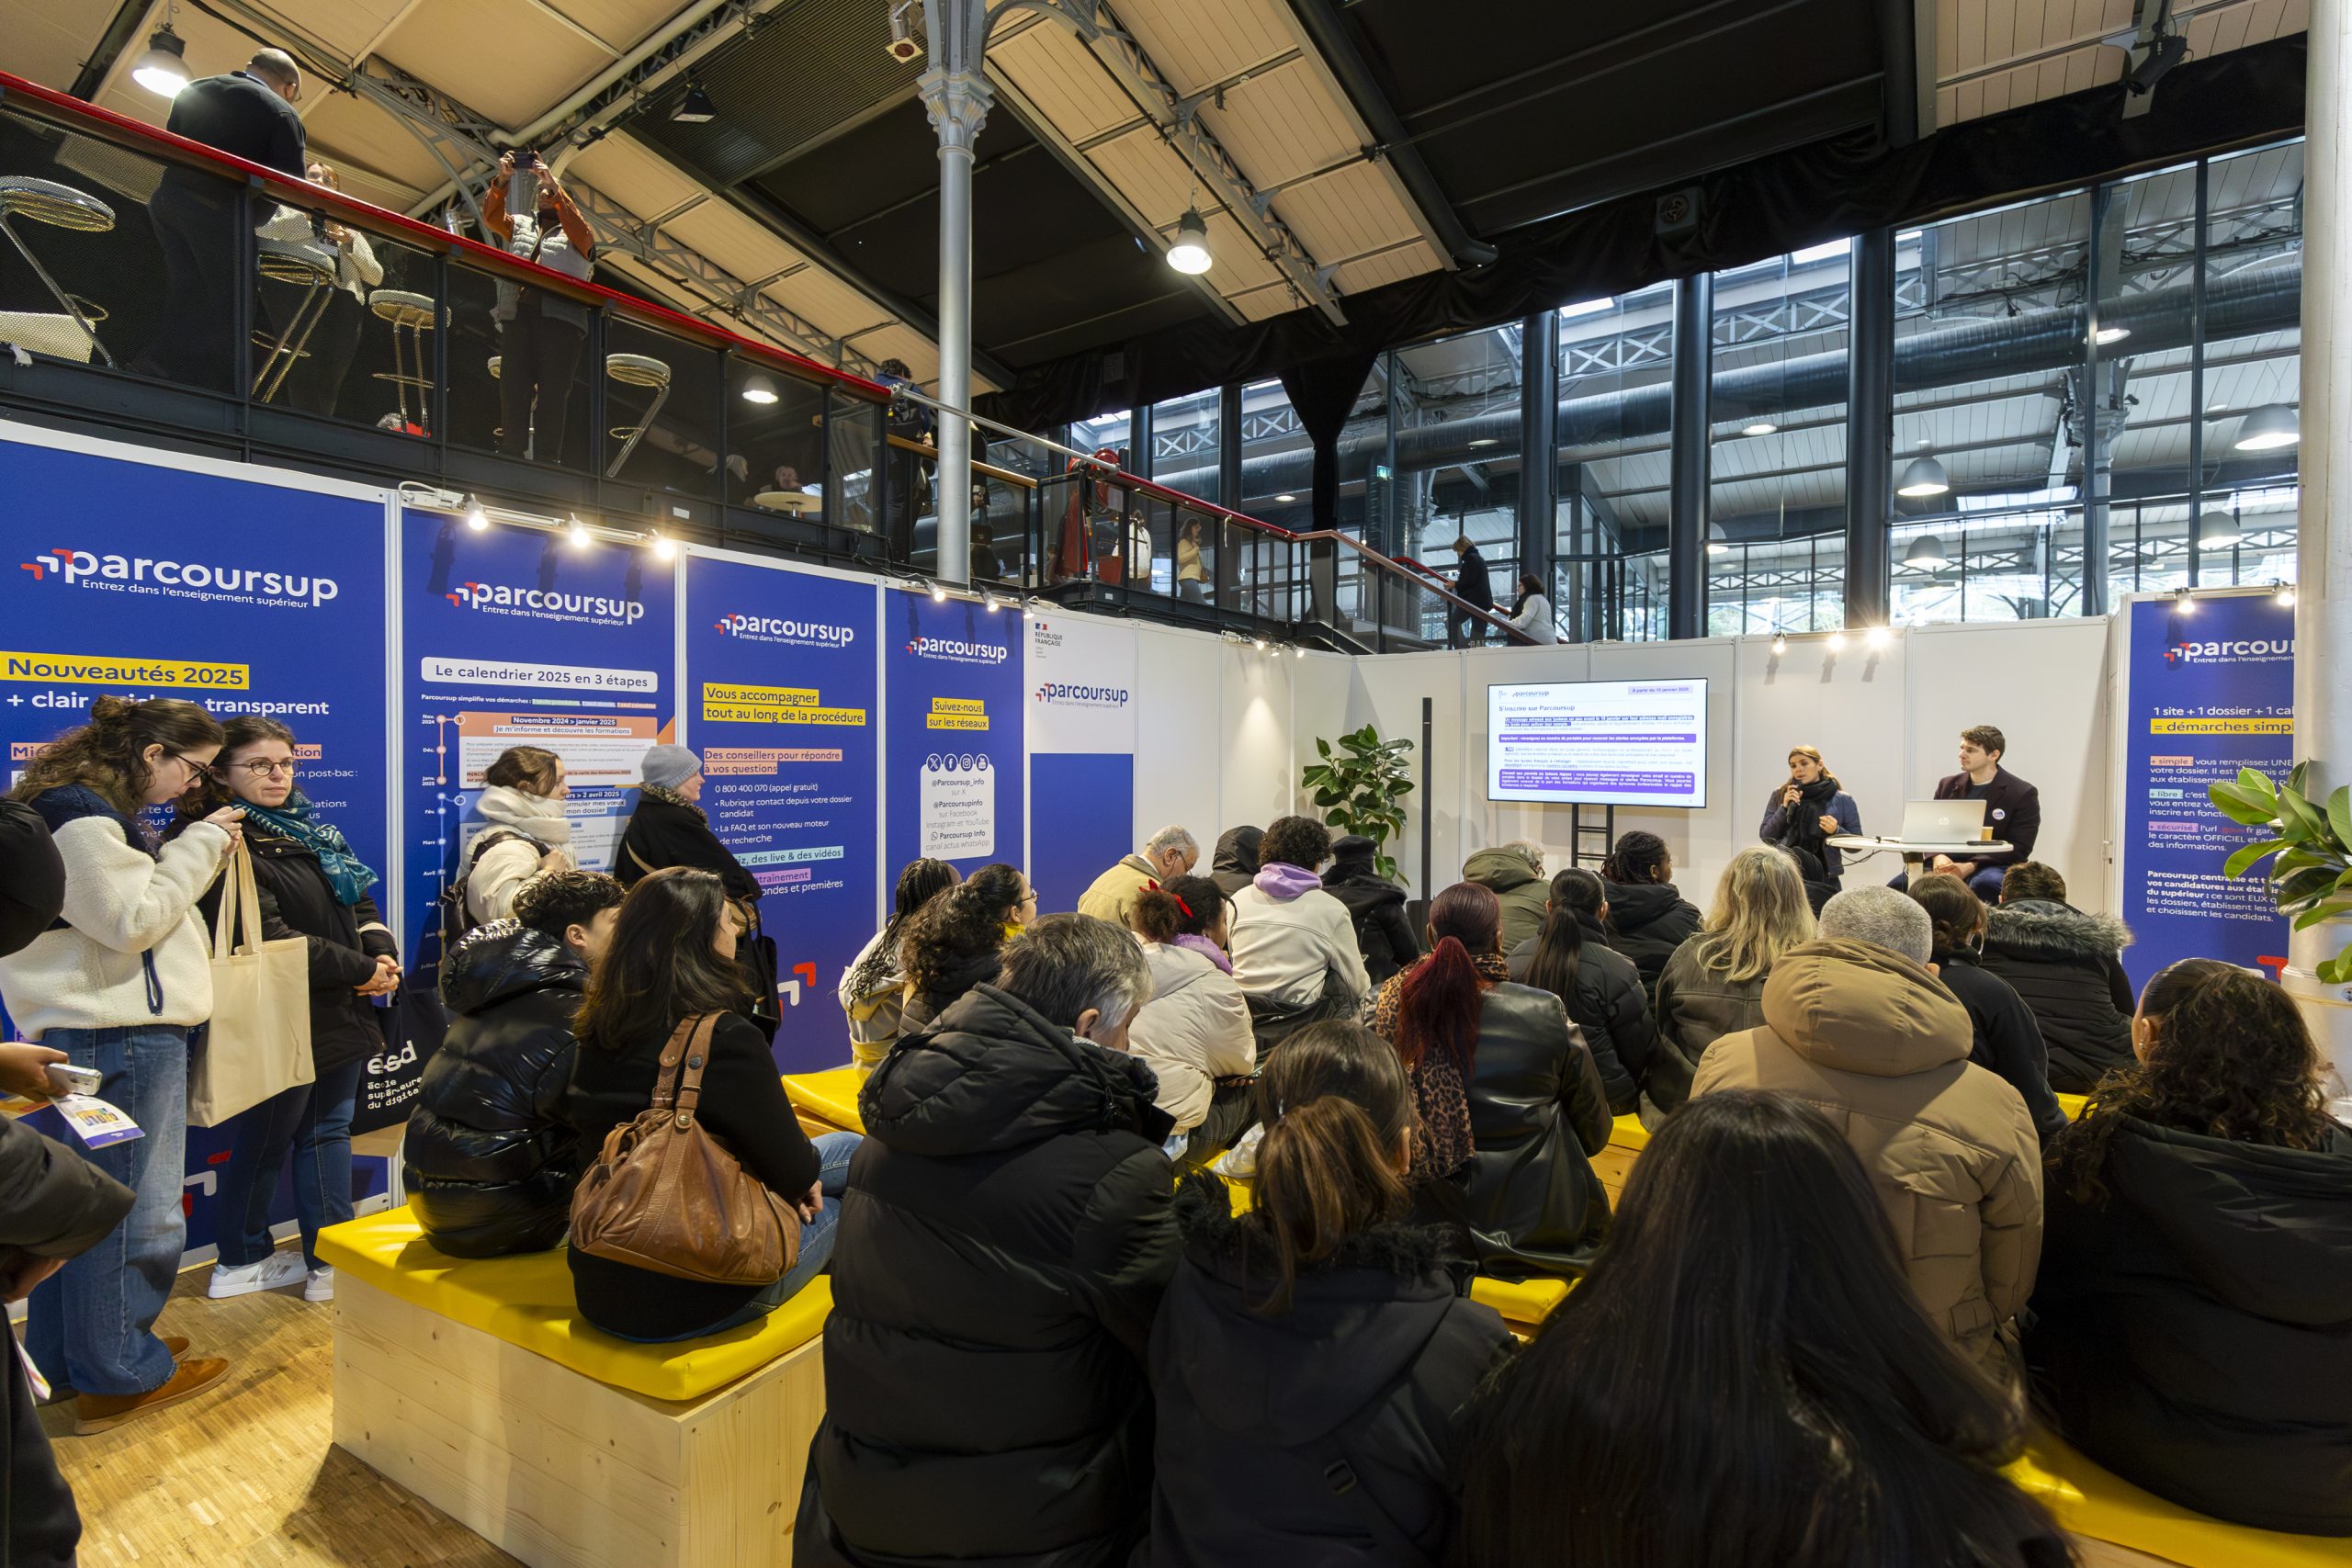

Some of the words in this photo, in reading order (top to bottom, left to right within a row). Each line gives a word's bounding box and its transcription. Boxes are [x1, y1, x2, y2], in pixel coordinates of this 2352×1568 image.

[64, 551, 338, 607] parcoursup
[83, 580, 125, 592] Entrez
[128, 584, 159, 595] dans
[163, 586, 254, 602] l'enseignement
[256, 597, 309, 608] supérieur
[472, 583, 644, 625] parcoursup
[482, 605, 509, 615] Entrez
[532, 610, 589, 622] l'enseignement
[591, 617, 625, 626] supérieur
[732, 615, 854, 647] parcoursup
[1035, 631, 1062, 640] RÉPUBLIQUE
[919, 637, 1007, 663] parcoursup
[8, 658, 175, 682] Nouveautés
[183, 667, 243, 685] 2025
[435, 664, 453, 675] Le
[458, 667, 533, 681] calendrier
[537, 671, 571, 682] 2025
[575, 675, 591, 683] en
[594, 674, 603, 684] 3
[606, 674, 648, 689] étapes
[421, 694, 457, 702] Parcoursup
[707, 687, 737, 699] Vous
[740, 691, 816, 705] accompagner
[1047, 683, 1128, 707] parcoursup
[7, 694, 24, 706] +
[31, 691, 89, 708] clair
[205, 698, 329, 716] transparent
[935, 701, 982, 712] Suivez-nous
[707, 707, 732, 718] tout
[736, 710, 751, 719] au
[753, 708, 778, 723] long
[781, 710, 796, 720] de
[798, 710, 808, 721] la
[810, 711, 863, 725] procédure
[2163, 706, 2184, 716] site
[2198, 706, 2203, 715] 1
[2207, 706, 2252, 716] dossier
[2267, 706, 2271, 715] 1
[944, 717, 955, 727] les
[956, 717, 987, 728] réseaux
[2167, 722, 2249, 732] démarches
[705, 751, 723, 760] Des
[726, 750, 775, 760] conseillers
[777, 752, 798, 762] pour
[801, 751, 840, 761] répondre
[2159, 758, 2188, 766] simple
[2219, 759, 2268, 767] remplissez
[705, 764, 710, 773] à
[731, 762, 777, 776] questions
[722, 784, 737, 793] 800
[739, 784, 752, 793] 400
[769, 784, 792, 793] (appel
[793, 784, 819, 793] gratuit)
[932, 778, 984, 787] @Parcoursup_info
[719, 799, 754, 808] Rubrique
[756, 798, 785, 807] contact
[786, 797, 809, 807] depuis
[830, 795, 853, 804] dossier
[933, 799, 983, 808] @Parcoursupinfo
[719, 809, 754, 818] candidat
[730, 823, 747, 832] FAQ
[2157, 823, 2193, 831] sécurisé
[731, 834, 772, 844] recherche
[2158, 833, 2201, 841] caractère
[2165, 842, 2227, 852] informations.
[752, 854, 768, 863] des
[770, 853, 786, 862] live
[797, 851, 812, 860] des
[814, 849, 841, 859] vidéos
[2147, 871, 2199, 881] Parcoursup
[802, 879, 843, 893] premières
[2164, 882, 2224, 891] candidatures
[2161, 890, 2204, 899] supérieur
[2160, 898, 2199, 908] dossiers,
[2200, 900, 2251, 911] établissent
[2158, 907, 2207, 918] choisissent
[2210, 910, 2222, 919] les
[2224, 912, 2273, 922] candidats.
[368, 1101, 381, 1110] du
[386, 1088, 419, 1106] digita
